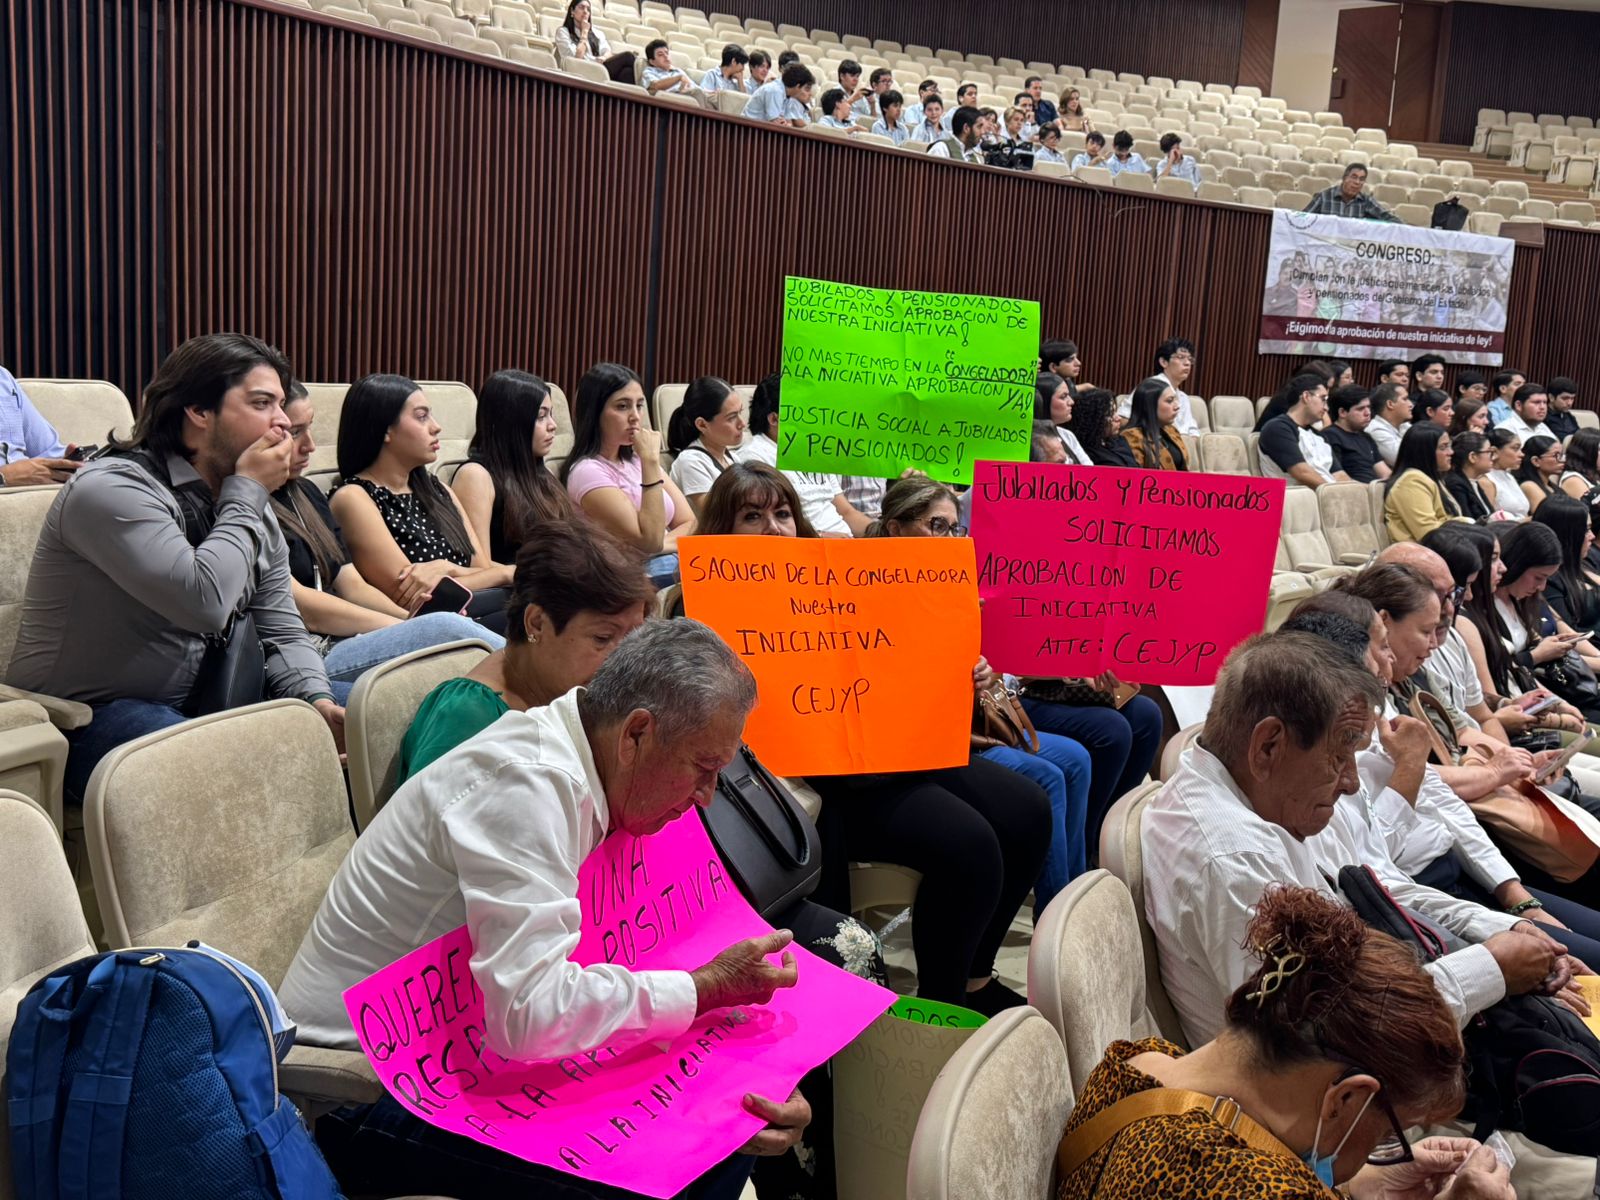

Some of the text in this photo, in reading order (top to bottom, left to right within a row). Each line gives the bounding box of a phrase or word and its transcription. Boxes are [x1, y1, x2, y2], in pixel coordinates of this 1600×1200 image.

[1551, 161, 1560, 175] M
[1356, 241, 1436, 265] CONGRESO:
[786, 277, 876, 301] JUBILADOS
[901, 291, 1023, 314] PENSIONADOS
[786, 291, 1028, 330] SOLICITAMOS APROBACION DE
[787, 308, 860, 328] NUESTRA
[1336, 325, 1385, 339] aprobación
[1386, 328, 1397, 340] de
[1397, 330, 1428, 342] nuestra
[1429, 331, 1464, 344] iniciativa
[1465, 334, 1475, 345] de
[1476, 335, 1493, 348] ley!
[782, 345, 804, 364] NO
[808, 347, 842, 366] MAS
[845, 352, 899, 371] TIEMPO
[904, 358, 922, 372] EN
[926, 360, 942, 374] LA
[780, 364, 792, 378] A
[794, 363, 814, 379] LA
[906, 375, 1004, 397] APROBACION
[998, 387, 1033, 419] YA!
[780, 404, 1028, 445] JUSTICIA SOCIAL A JUBILADOS
[781, 431, 797, 456] Y
[1138, 475, 1271, 512] Pensionados
[1063, 515, 1222, 558] SOLICITAMOS
[689, 555, 971, 587] SAQUEN DE LA CONGELADORA
[977, 551, 1184, 592] APROBACION DE
[790, 596, 857, 616] Nuestra
[1011, 596, 1159, 621] INICIATIVA
[1035, 637, 1105, 658] ATTE:
[791, 677, 871, 715] CEJYP
[602, 859, 728, 966] POSITIVA
[360, 835, 652, 1062] QUERE UNA
[464, 1113, 505, 1140] A
[495, 1082, 557, 1121] LA
[559, 1146, 592, 1170] A
[585, 1116, 638, 1154] LA
